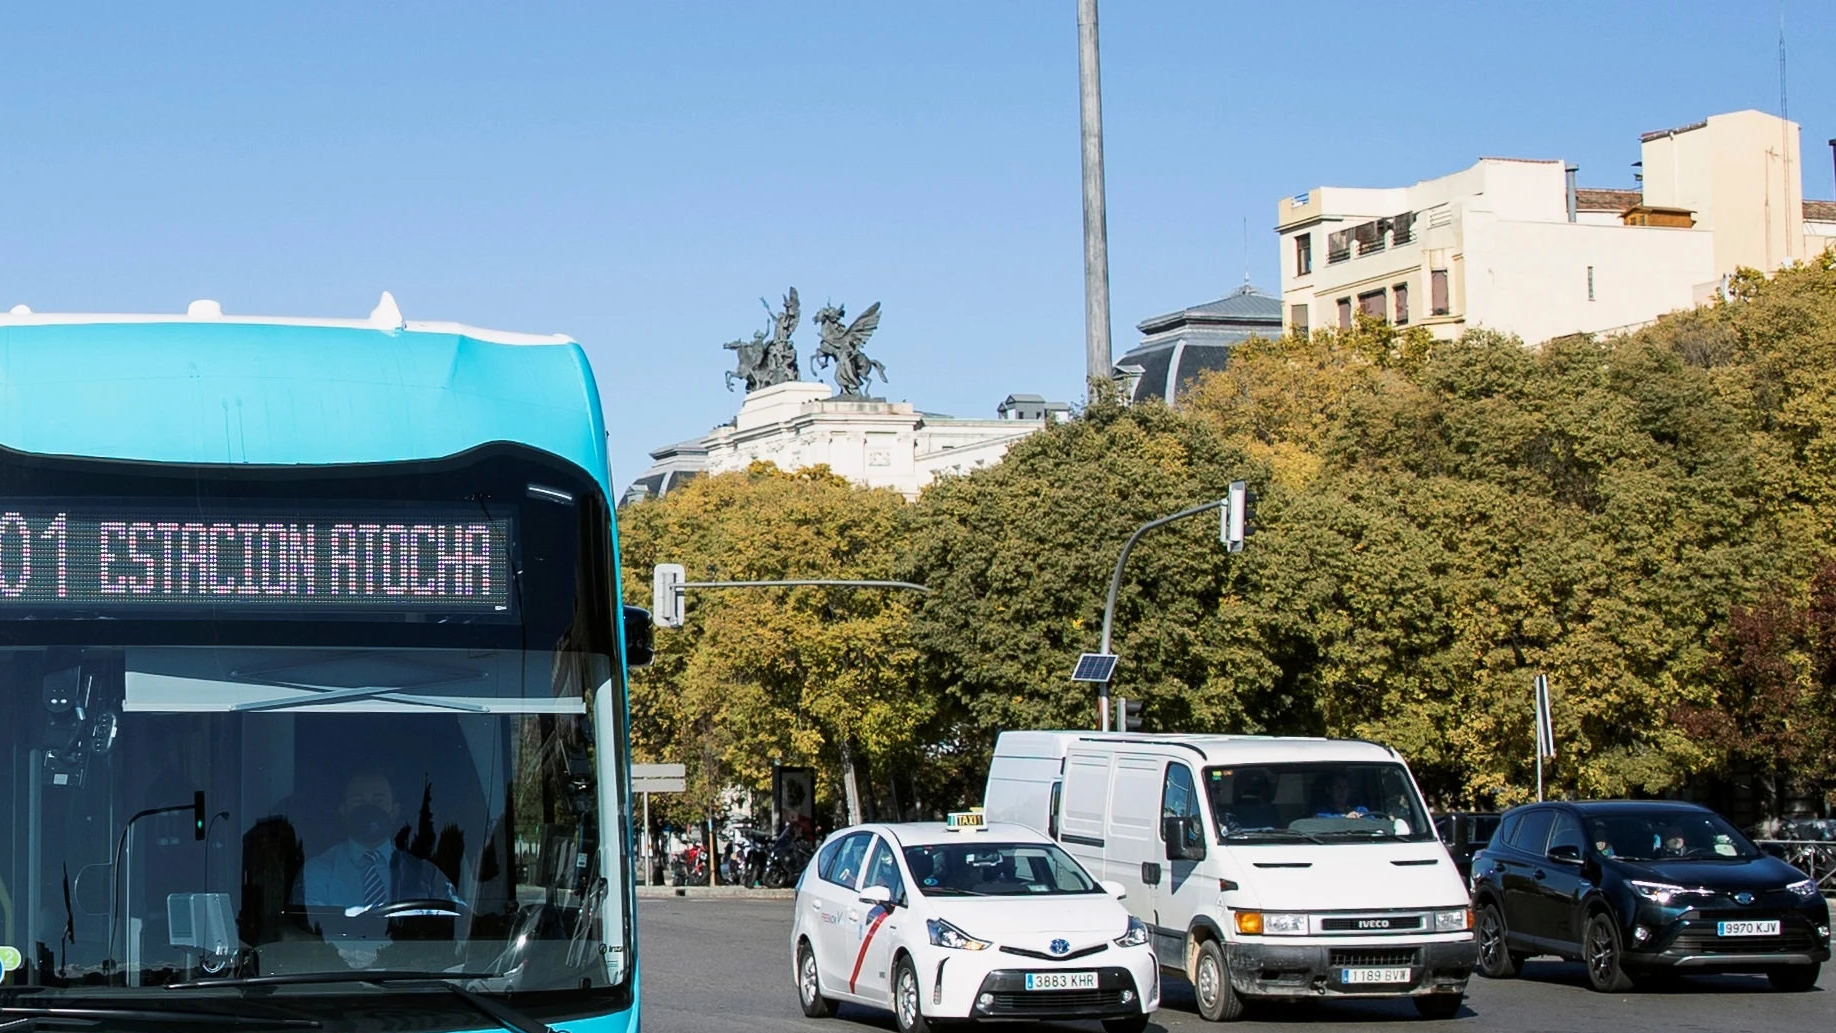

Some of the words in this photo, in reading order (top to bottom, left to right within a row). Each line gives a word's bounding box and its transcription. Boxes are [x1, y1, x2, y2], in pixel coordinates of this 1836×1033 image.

[100, 521, 315, 595] ESTACION
[330, 523, 491, 596] ATOCHA
[1358, 920, 1390, 929] IVECO
[1726, 923, 1754, 934] 9970
[1756, 922, 1777, 933] KJV
[1035, 975, 1067, 988] 3883
[1071, 974, 1095, 987] KHR
[1353, 970, 1382, 982] 1189
